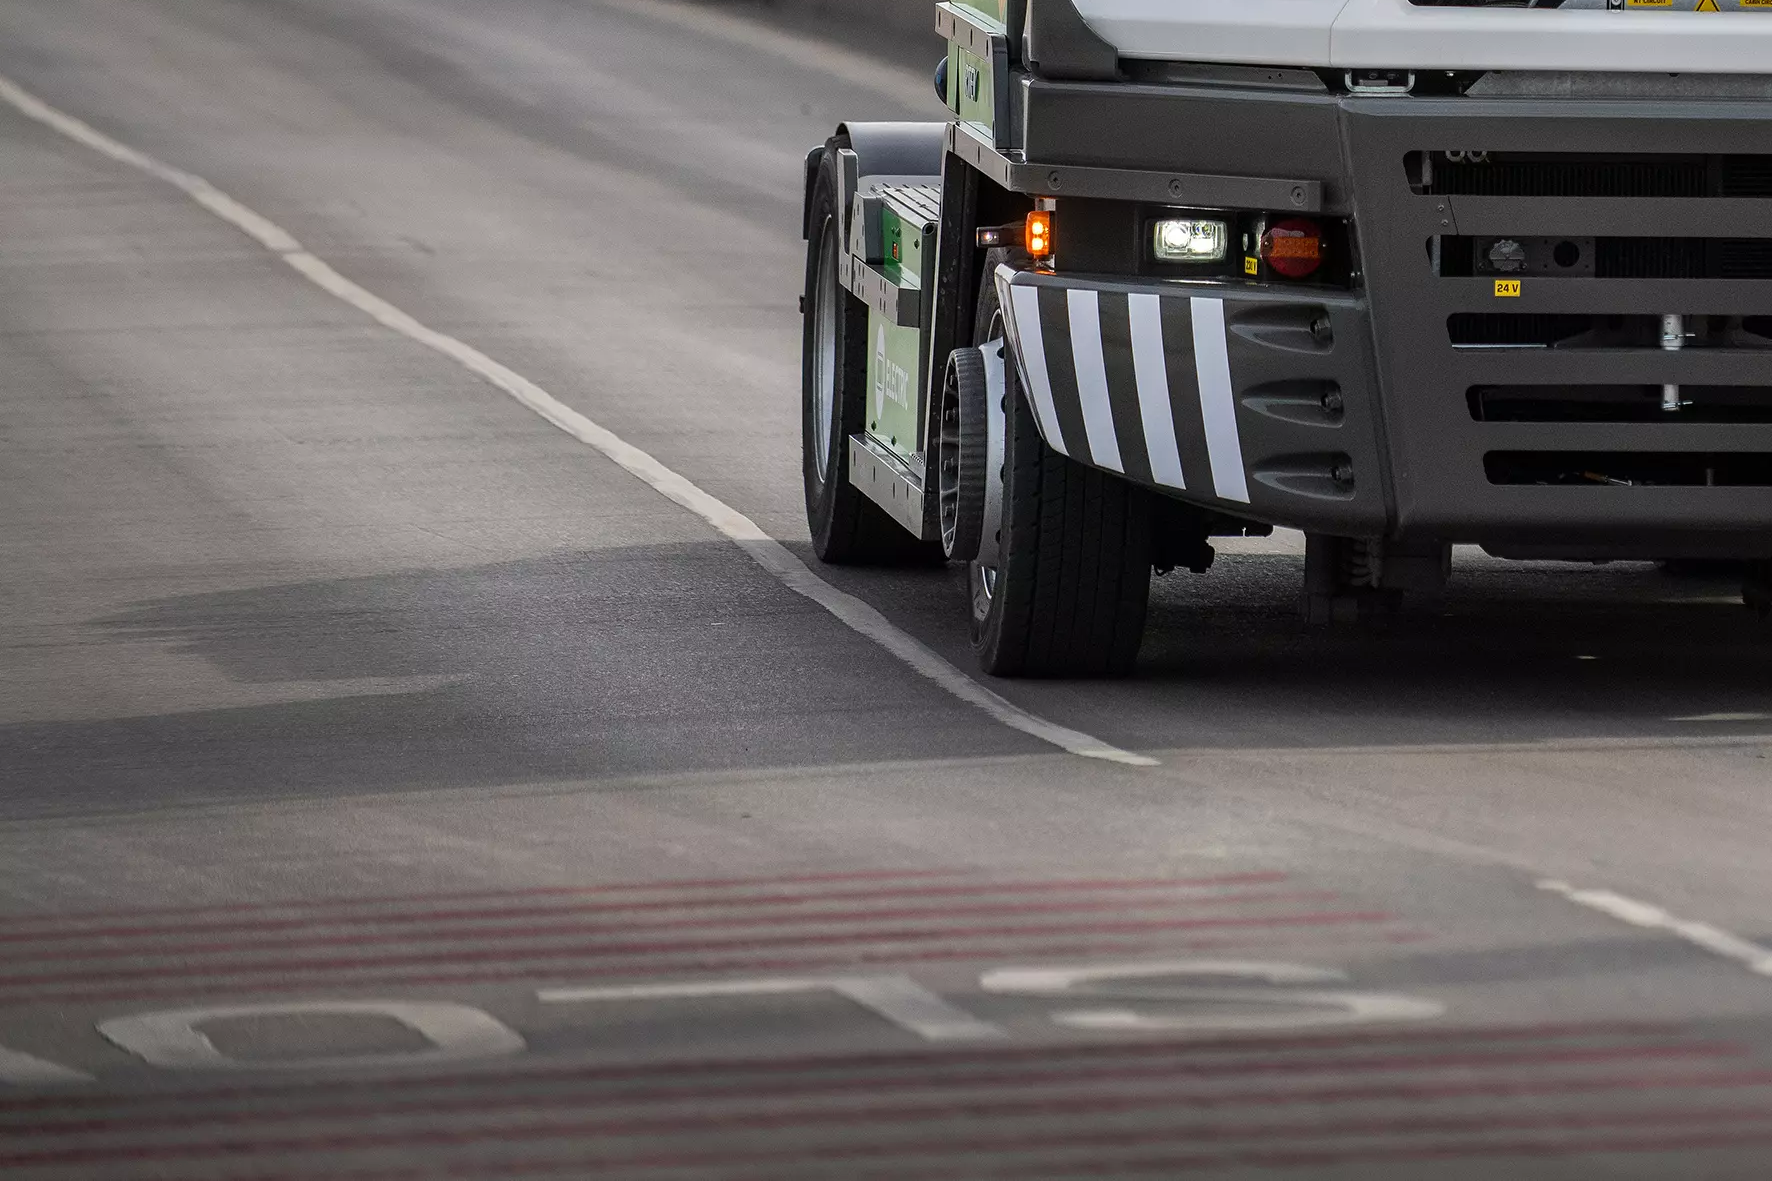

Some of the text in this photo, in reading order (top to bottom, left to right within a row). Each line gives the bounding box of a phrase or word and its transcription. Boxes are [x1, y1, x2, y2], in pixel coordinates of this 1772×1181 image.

[1497, 283, 1519, 293] 24 V
[885, 358, 909, 411] ELECTRIC
[0, 957, 1447, 1083] SLO
